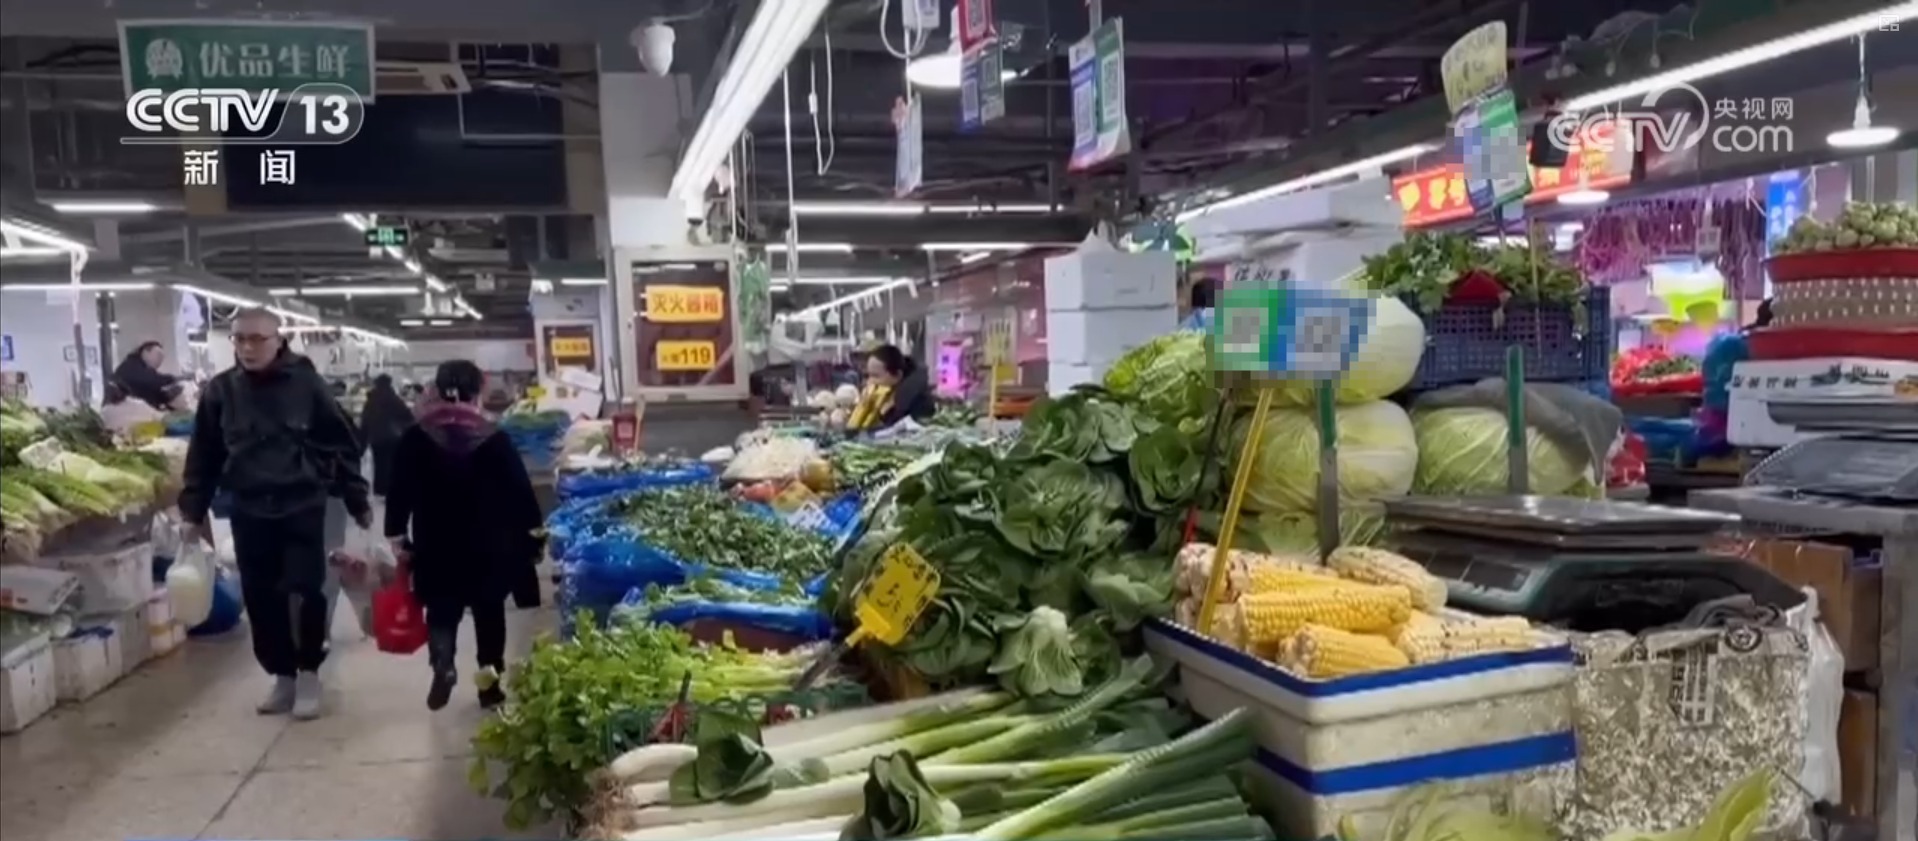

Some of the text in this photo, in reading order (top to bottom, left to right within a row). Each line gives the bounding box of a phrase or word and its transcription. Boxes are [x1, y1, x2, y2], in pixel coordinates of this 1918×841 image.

[199, 41, 350, 79] 优品生鲜
[660, 346, 711, 365] 119
